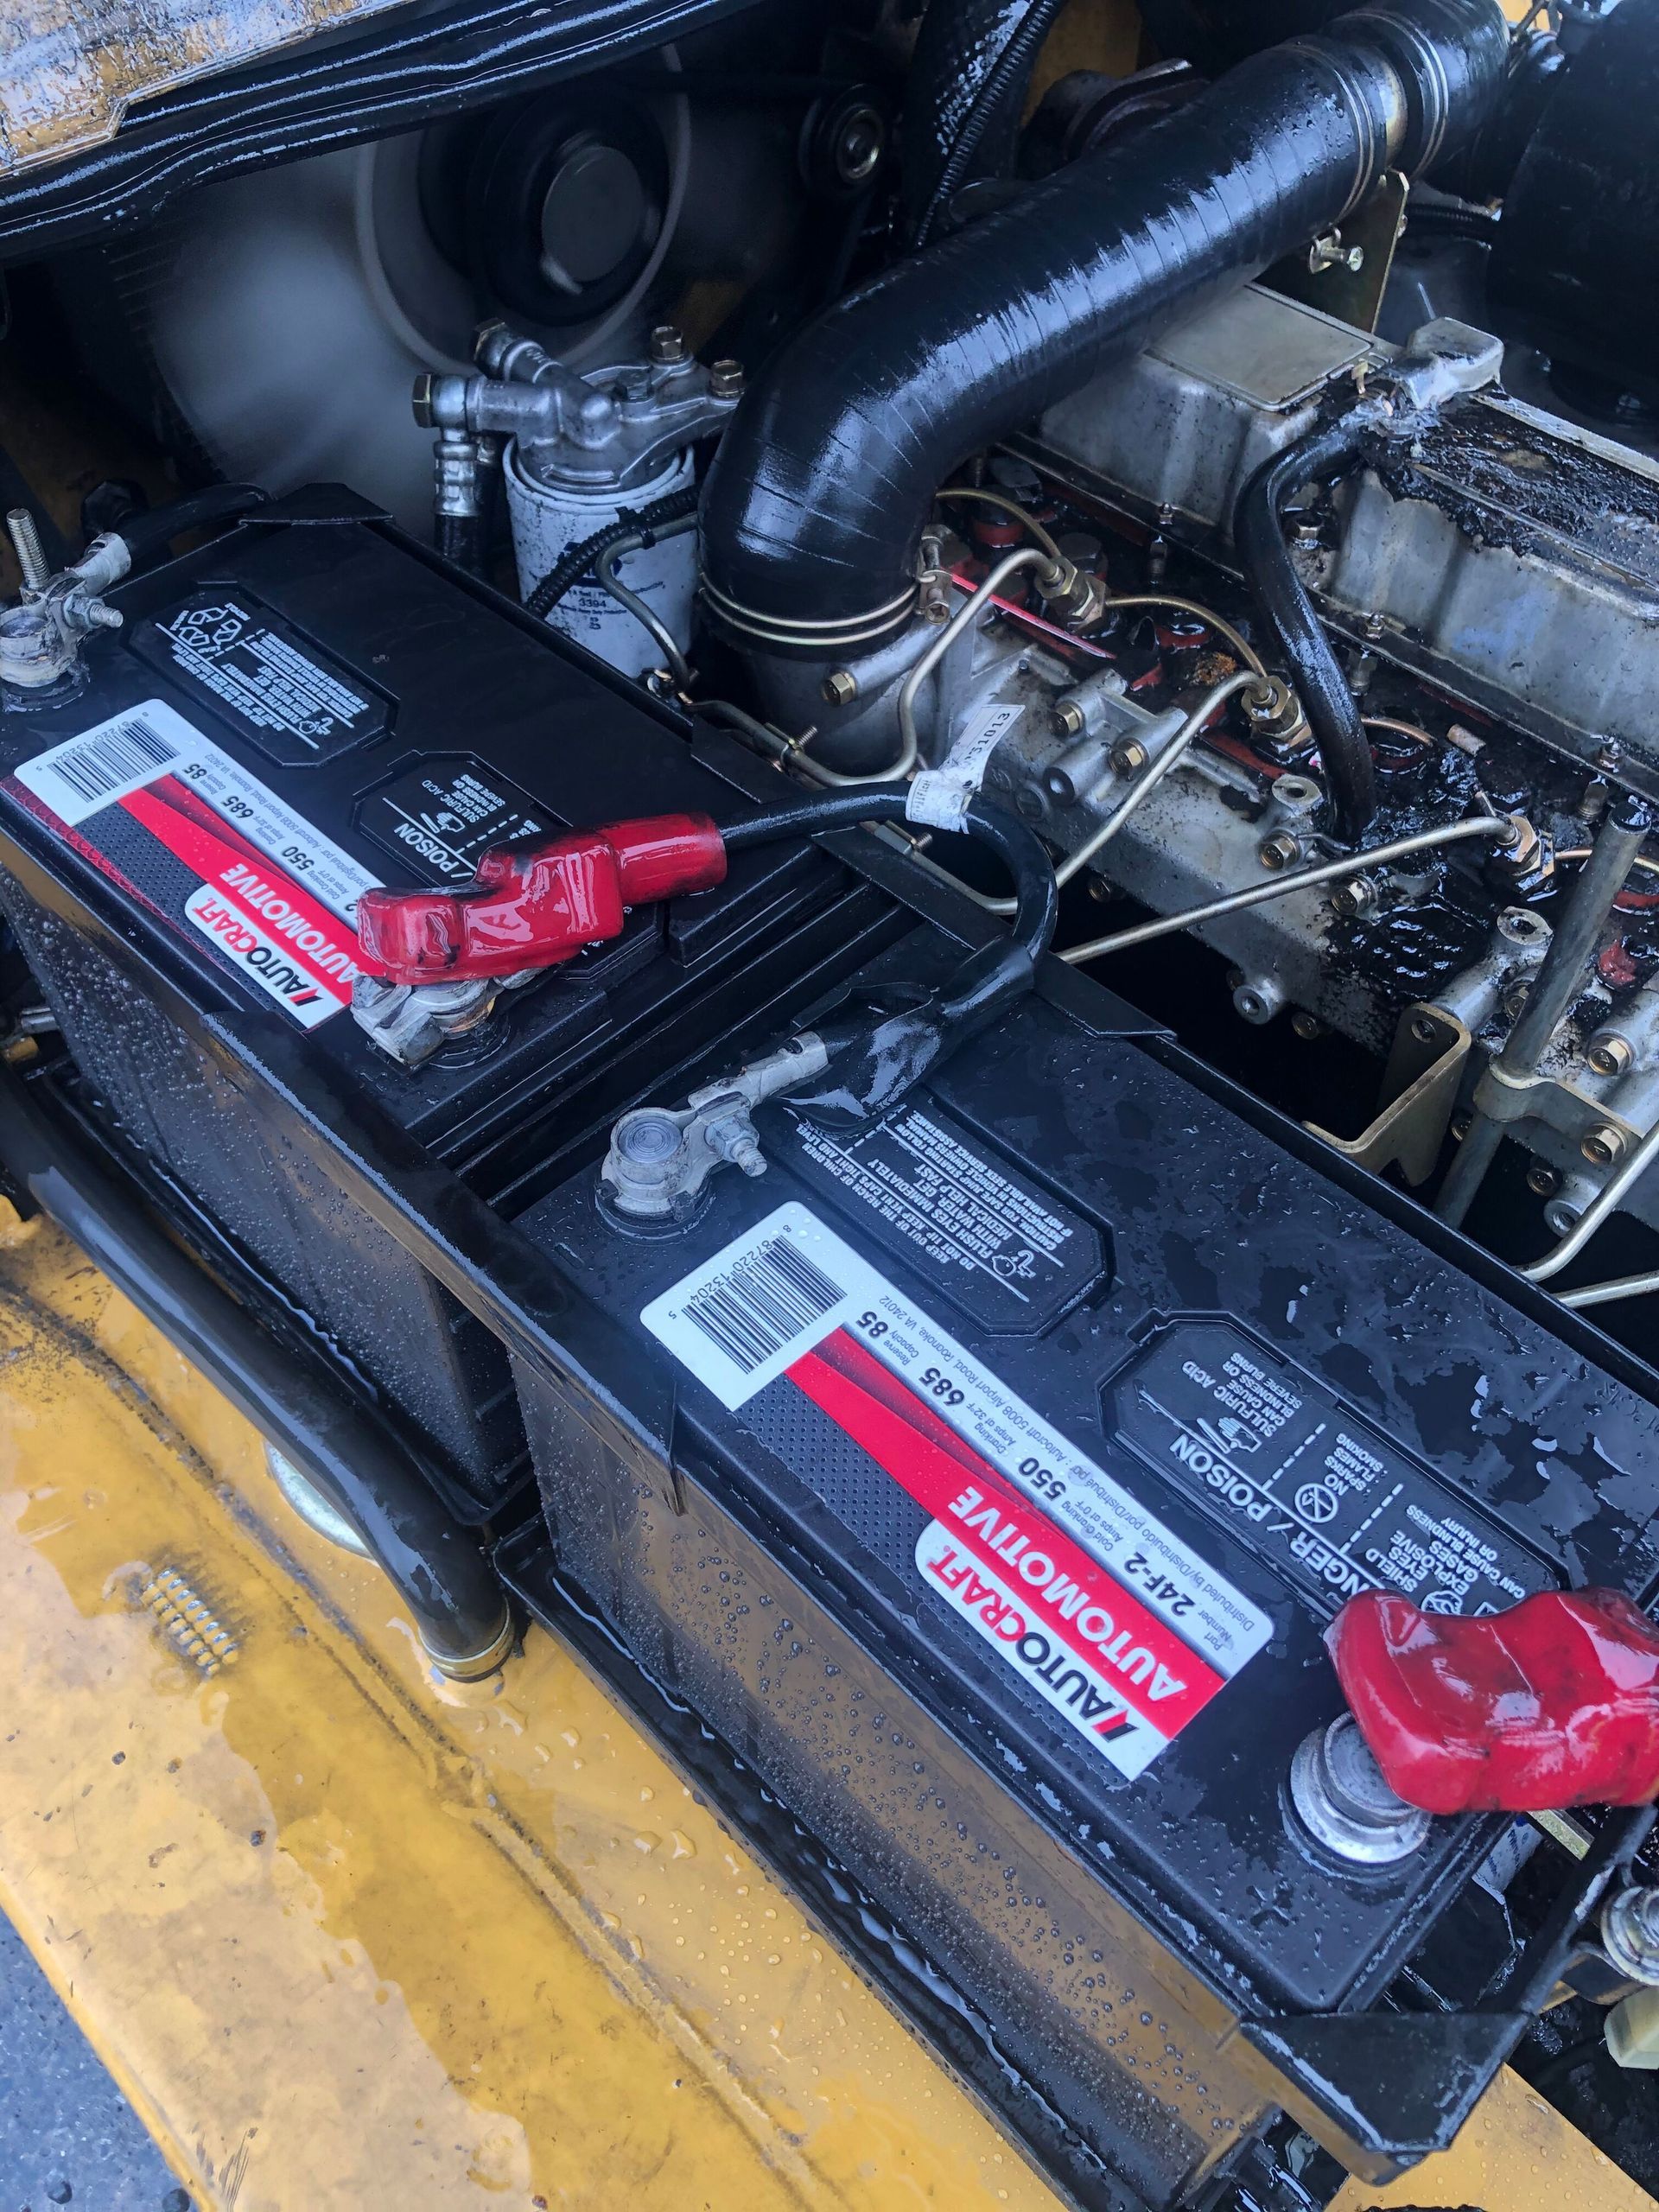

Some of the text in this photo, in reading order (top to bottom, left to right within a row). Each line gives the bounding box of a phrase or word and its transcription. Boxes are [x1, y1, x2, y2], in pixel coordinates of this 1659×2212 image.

[220, 663, 302, 723] FLUSH EYES IMMEDIATELY
[252, 674, 271, 686] GET
[257, 665, 321, 712] MEDICAL HELP FAST
[289, 702, 311, 718] WITH
[182, 762, 207, 779] 85
[421, 779, 480, 823] SULFURIC ACID
[451, 790, 488, 817] CAN CAUSE
[452, 779, 497, 811] BLINDNESS OR
[460, 773, 505, 806] SEVERE BURNS
[220, 795, 254, 819] 685
[281, 845, 315, 871] 550
[393, 823, 460, 872] POISON
[219, 862, 369, 988] AUTOMOTIVE
[191, 899, 310, 1002] AUTOCRAFT
[794, 1123, 822, 1145] LEVEL
[817, 1142, 838, 1158] AND
[893, 1123, 928, 1150] FOLLOW
[834, 1156, 864, 1179] TIGHT
[923, 1146, 963, 1178] STARTING
[933, 1142, 969, 1170] OWNERS
[952, 1145, 988, 1173] SERVICE
[857, 1175, 883, 1196] CAPS
[958, 1175, 984, 1193] JUMP
[964, 1166, 1000, 1194] VEHICLE
[983, 1168, 1007, 1187] SEEK
[800, 1141, 950, 1263] KEEP OUT OF THE REACH OF CHILDREN
[866, 1158, 994, 1258] FLUSH EYES IMMEDIATELY
[880, 1193, 906, 1214] VENT
[913, 1163, 1013, 1240] MEDICAL HELP FAST
[980, 1191, 1004, 1210] SAFE
[995, 1190, 1009, 1201] IN
[1002, 1183, 1048, 1217] AVAILABLE
[900, 1211, 926, 1230] KEEP
[912, 1179, 1002, 1249] WITH WATER. GET
[999, 1205, 1020, 1222] FOR
[1005, 1198, 1065, 1243] INSTRUCTIONS
[1043, 1214, 1064, 1230] NOT
[1059, 1227, 1073, 1236] IF
[940, 1242, 962, 1260] NOT
[957, 1256, 976, 1270] DO
[667, 1224, 791, 1319] 8 87220 13204 5
[878, 1294, 908, 1320] 24012
[903, 1315, 918, 1330] VA
[855, 1310, 889, 1339] 85
[882, 1339, 911, 1365] Reserve
[888, 1329, 919, 1357] Capacity
[917, 1326, 955, 1363] Roanoke,
[917, 1366, 965, 1408] 685
[951, 1358, 979, 1384] Road,
[1229, 1351, 1303, 1408] SEVERE BURNS
[973, 1379, 1007, 1408] Airport
[1180, 1360, 1278, 1437] SULFURIC ACID
[1221, 1360, 1295, 1418] BLINDNESS OR
[1225, 1379, 1287, 1426] CAN CAUSE
[965, 1402, 1017, 1446] Amps at 32°F
[1001, 1404, 1029, 1430] 5008
[973, 1421, 1007, 1454] Cranking
[1025, 1426, 1068, 1463] Autocraft
[1335, 1433, 1384, 1471] SMOKING
[1017, 1456, 1066, 1502] 550
[1168, 1433, 1274, 1522] POISON
[1323, 1455, 1367, 1491] SPARKS
[1332, 1446, 1376, 1481] FLAMES
[1323, 1473, 1350, 1496] NO
[1083, 1475, 1146, 1531] por/Distribué
[1060, 1500, 1114, 1551] Cold Cranking
[1074, 1499, 1124, 1542] Amps at 0°F
[1405, 1504, 1527, 1599] CAN CAUSE BLINDNESS
[1440, 1516, 1499, 1561] OR INJURY
[1141, 1527, 1206, 1588] by/Distribuido
[1287, 1531, 1370, 1595] NGER
[1363, 1548, 1419, 1592] SHIELD
[1386, 1546, 1429, 1580] EYES
[1388, 1529, 1471, 1595] EXPLOSIVE
[1427, 1540, 1480, 1582] GASES
[946, 1484, 1187, 1703] AUTOMOTIVE
[1122, 1551, 1196, 1618] 24F-2
[1201, 1582, 1255, 1631] Distributed
[925, 1548, 1116, 1730] AUTOCRAFT
[1197, 1609, 1232, 1643] Number
[1203, 1631, 1224, 1650] Part
